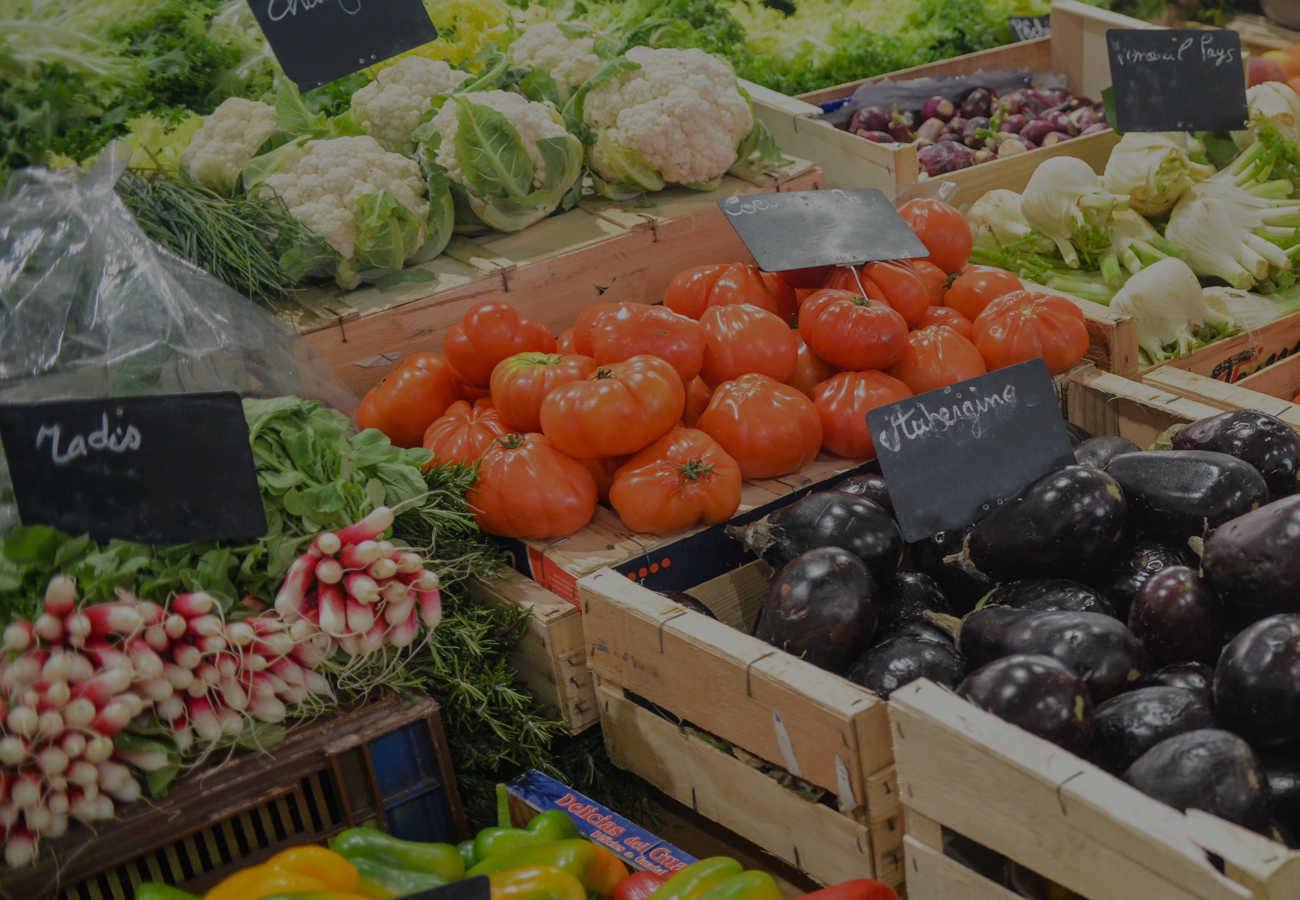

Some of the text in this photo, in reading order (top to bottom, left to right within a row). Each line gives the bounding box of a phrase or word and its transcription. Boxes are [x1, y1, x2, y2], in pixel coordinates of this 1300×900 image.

[1201, 32, 1235, 66] Pays
[555, 793, 626, 837] Delicias
[623, 836, 650, 853] del
